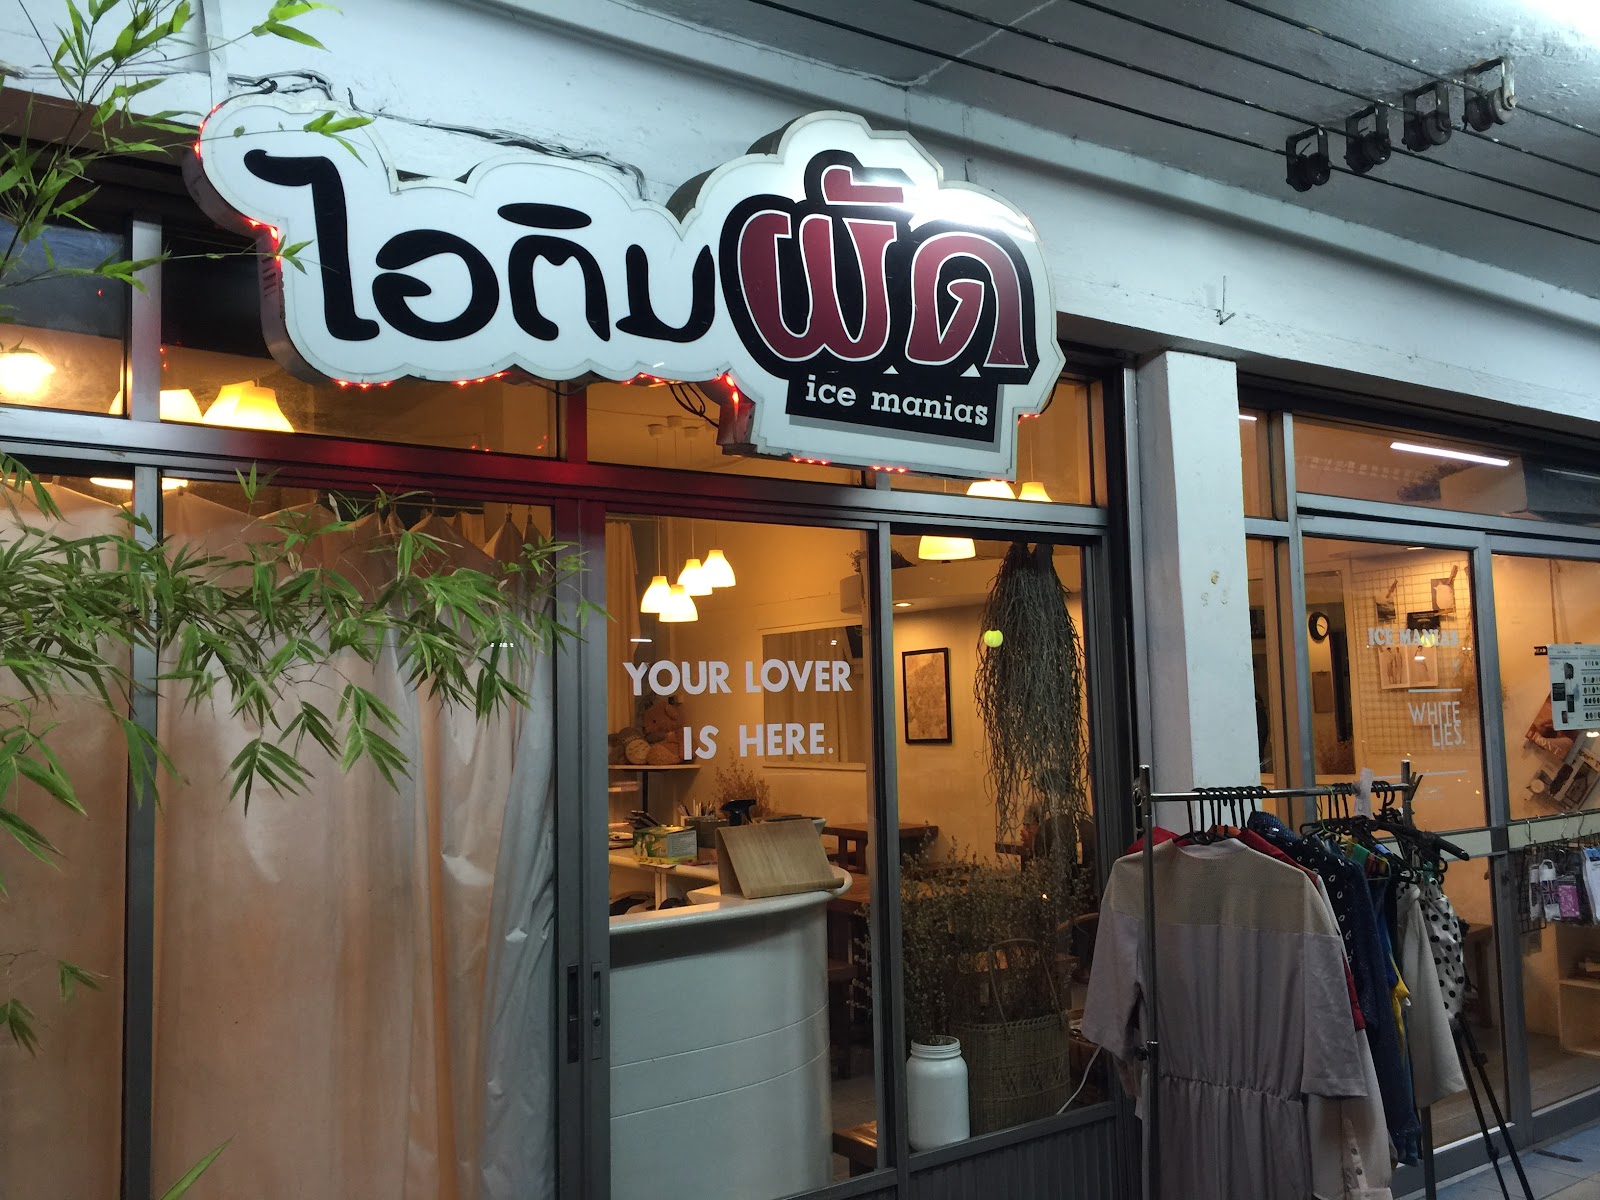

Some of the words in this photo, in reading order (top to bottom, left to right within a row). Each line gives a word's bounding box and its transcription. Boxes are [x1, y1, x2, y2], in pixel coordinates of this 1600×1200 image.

[805, 374, 857, 407] ice
[870, 390, 988, 426] manias
[1367, 627, 1394, 646] ICE
[1399, 628, 1459, 647] MANIAS
[623, 660, 732, 696] YOUR
[745, 659, 853, 693] LOVER
[1407, 701, 1461, 726] WHITE
[683, 725, 719, 760] IS
[739, 722, 834, 757] HERE.
